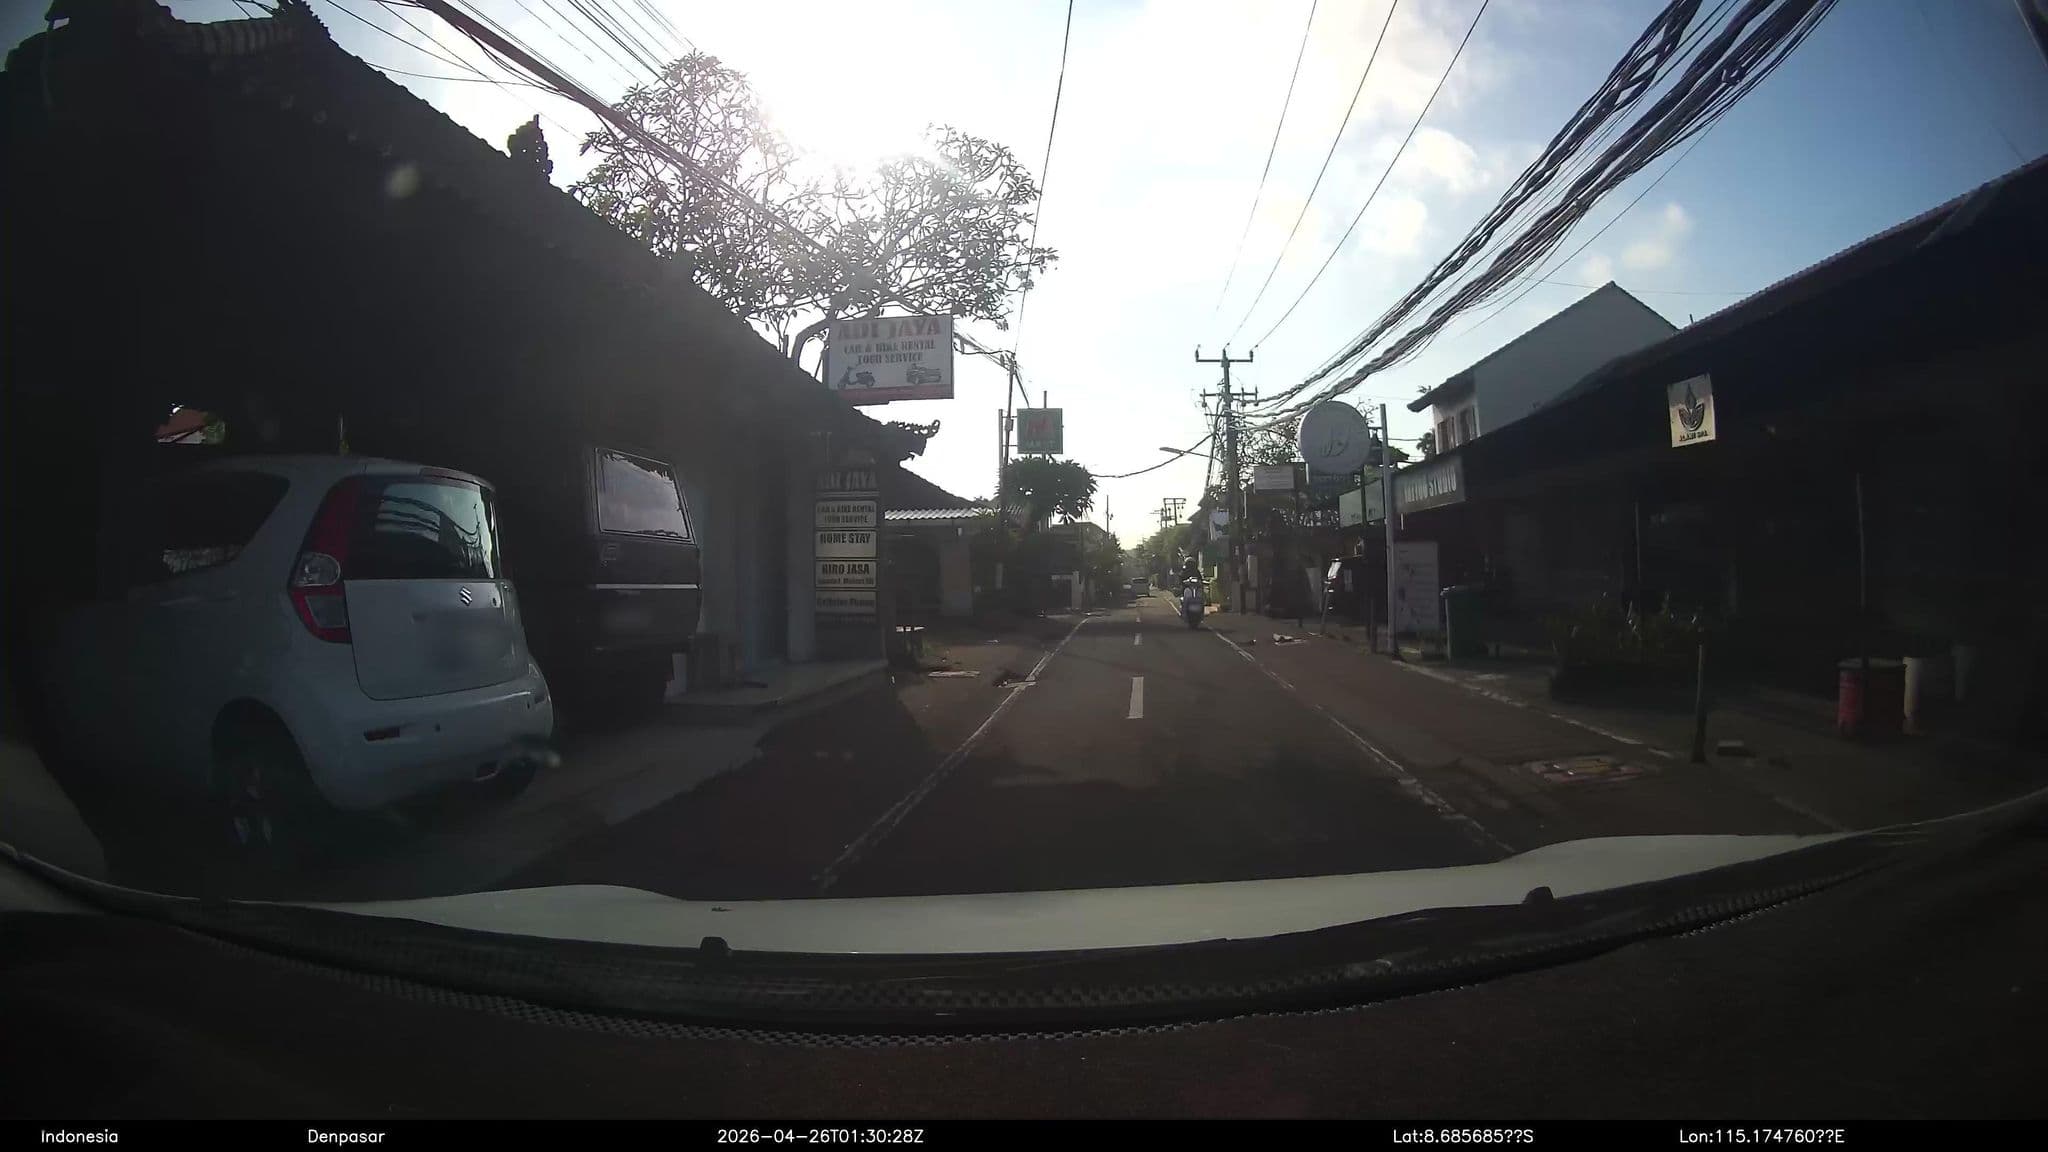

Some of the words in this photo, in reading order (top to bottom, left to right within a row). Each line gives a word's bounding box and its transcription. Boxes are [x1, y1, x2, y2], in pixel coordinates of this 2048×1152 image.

[838, 321, 880, 340] ADI
[888, 319, 942, 338] JAYA
[843, 343, 862, 354] CAR
[876, 342, 899, 353] BIKE
[901, 339, 936, 351] RENTAL
[858, 354, 882, 365] TOUR
[885, 352, 923, 363] SERVICE
[820, 532, 846, 545] HOME
[848, 532, 871, 545] STAY
[846, 563, 870, 575] JASA
